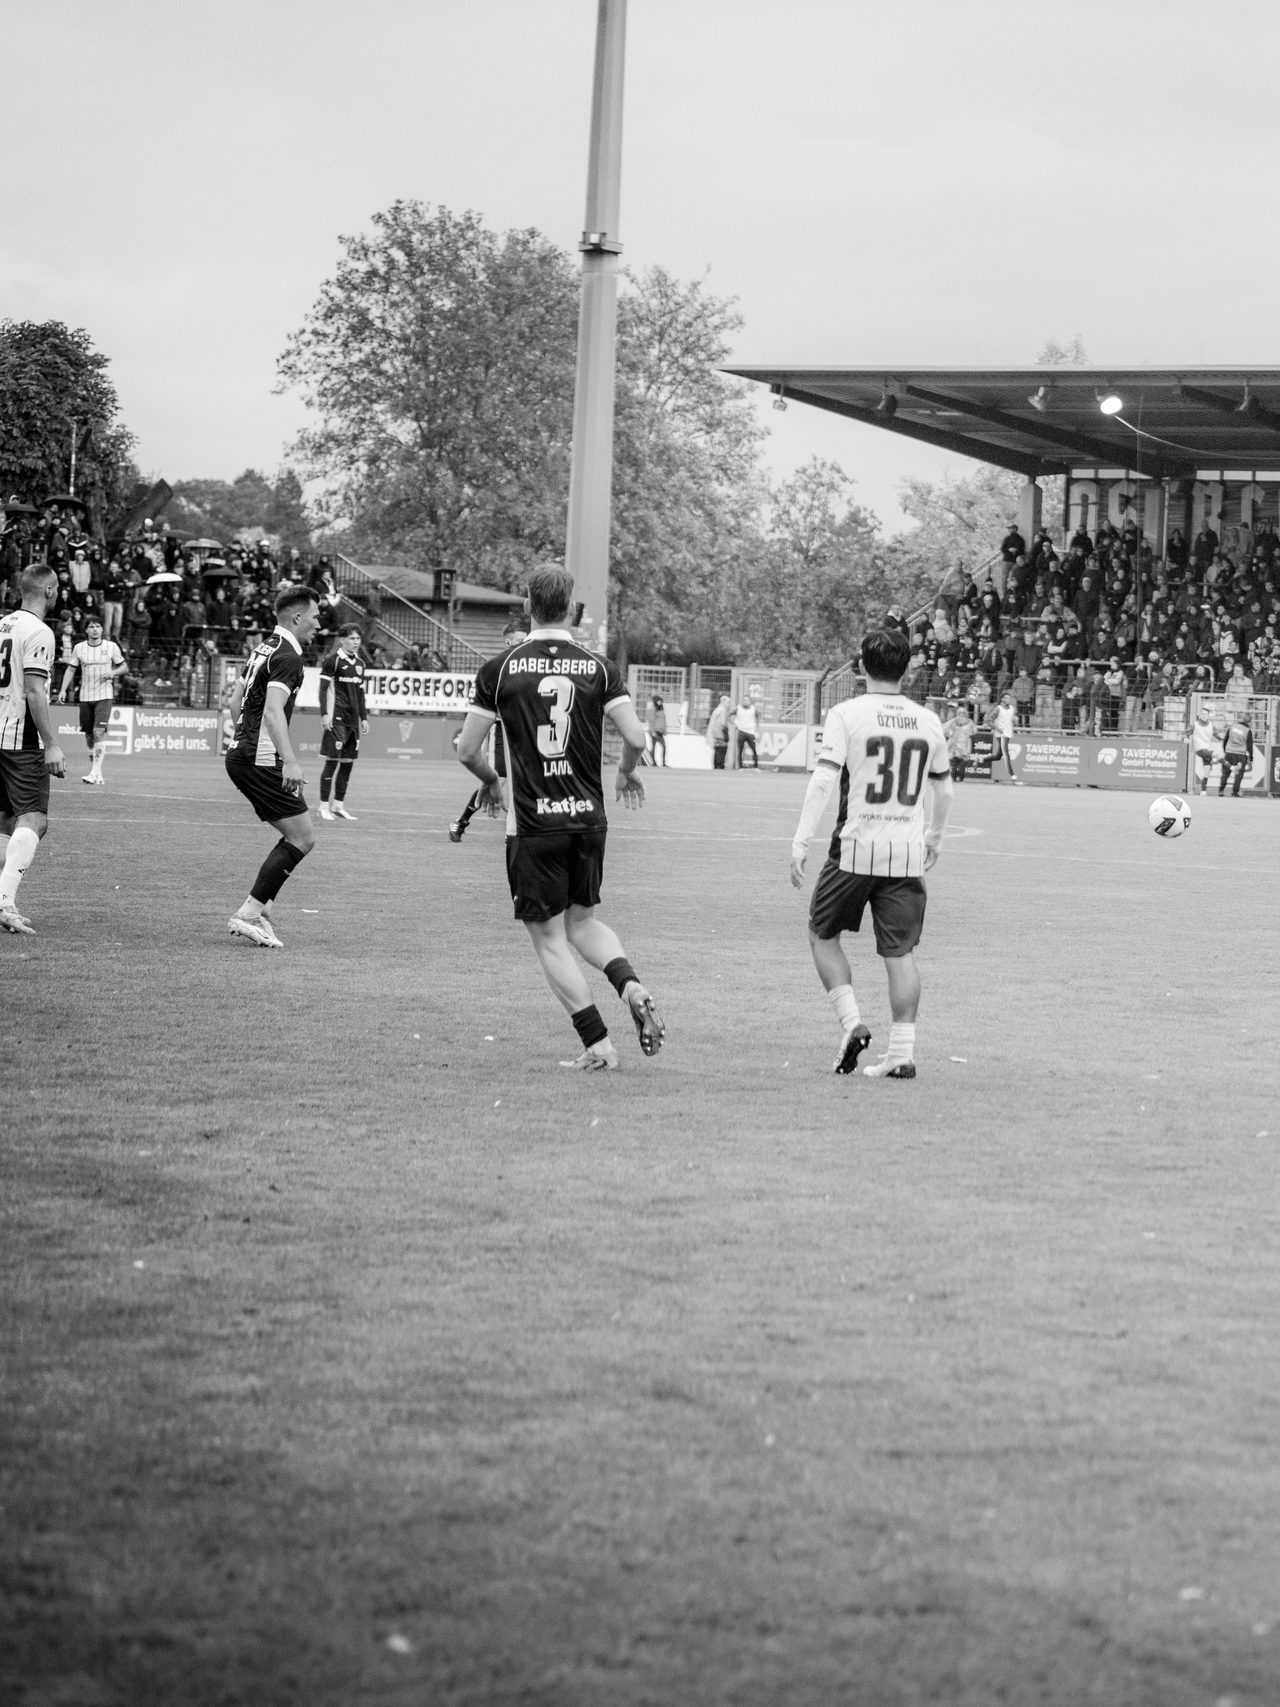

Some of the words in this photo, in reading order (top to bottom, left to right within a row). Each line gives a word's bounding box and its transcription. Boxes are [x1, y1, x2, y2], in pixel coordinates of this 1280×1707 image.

[509, 658, 597, 675] BABELSBERG
[364, 675, 471, 698] TIEGSREFOR
[134, 712, 218, 732] Versicherungen
[537, 675, 575, 758] 3
[877, 711, 919, 730] ÖZTÜRK
[134, 735, 164, 751] gibt's
[166, 736, 184, 750] bei
[185, 738, 210, 750] uns.
[1025, 744, 1080, 756] TAVERPACK
[1025, 754, 1048, 763] GmbH
[1049, 755, 1080, 764] Potsdam
[1121, 748, 1178, 760] TAVERPACK
[1121, 758, 1144, 767] GmbH
[1145, 759, 1177, 768] Potsdam
[865, 735, 930, 807] 30
[536, 796, 594, 817] Katjes
